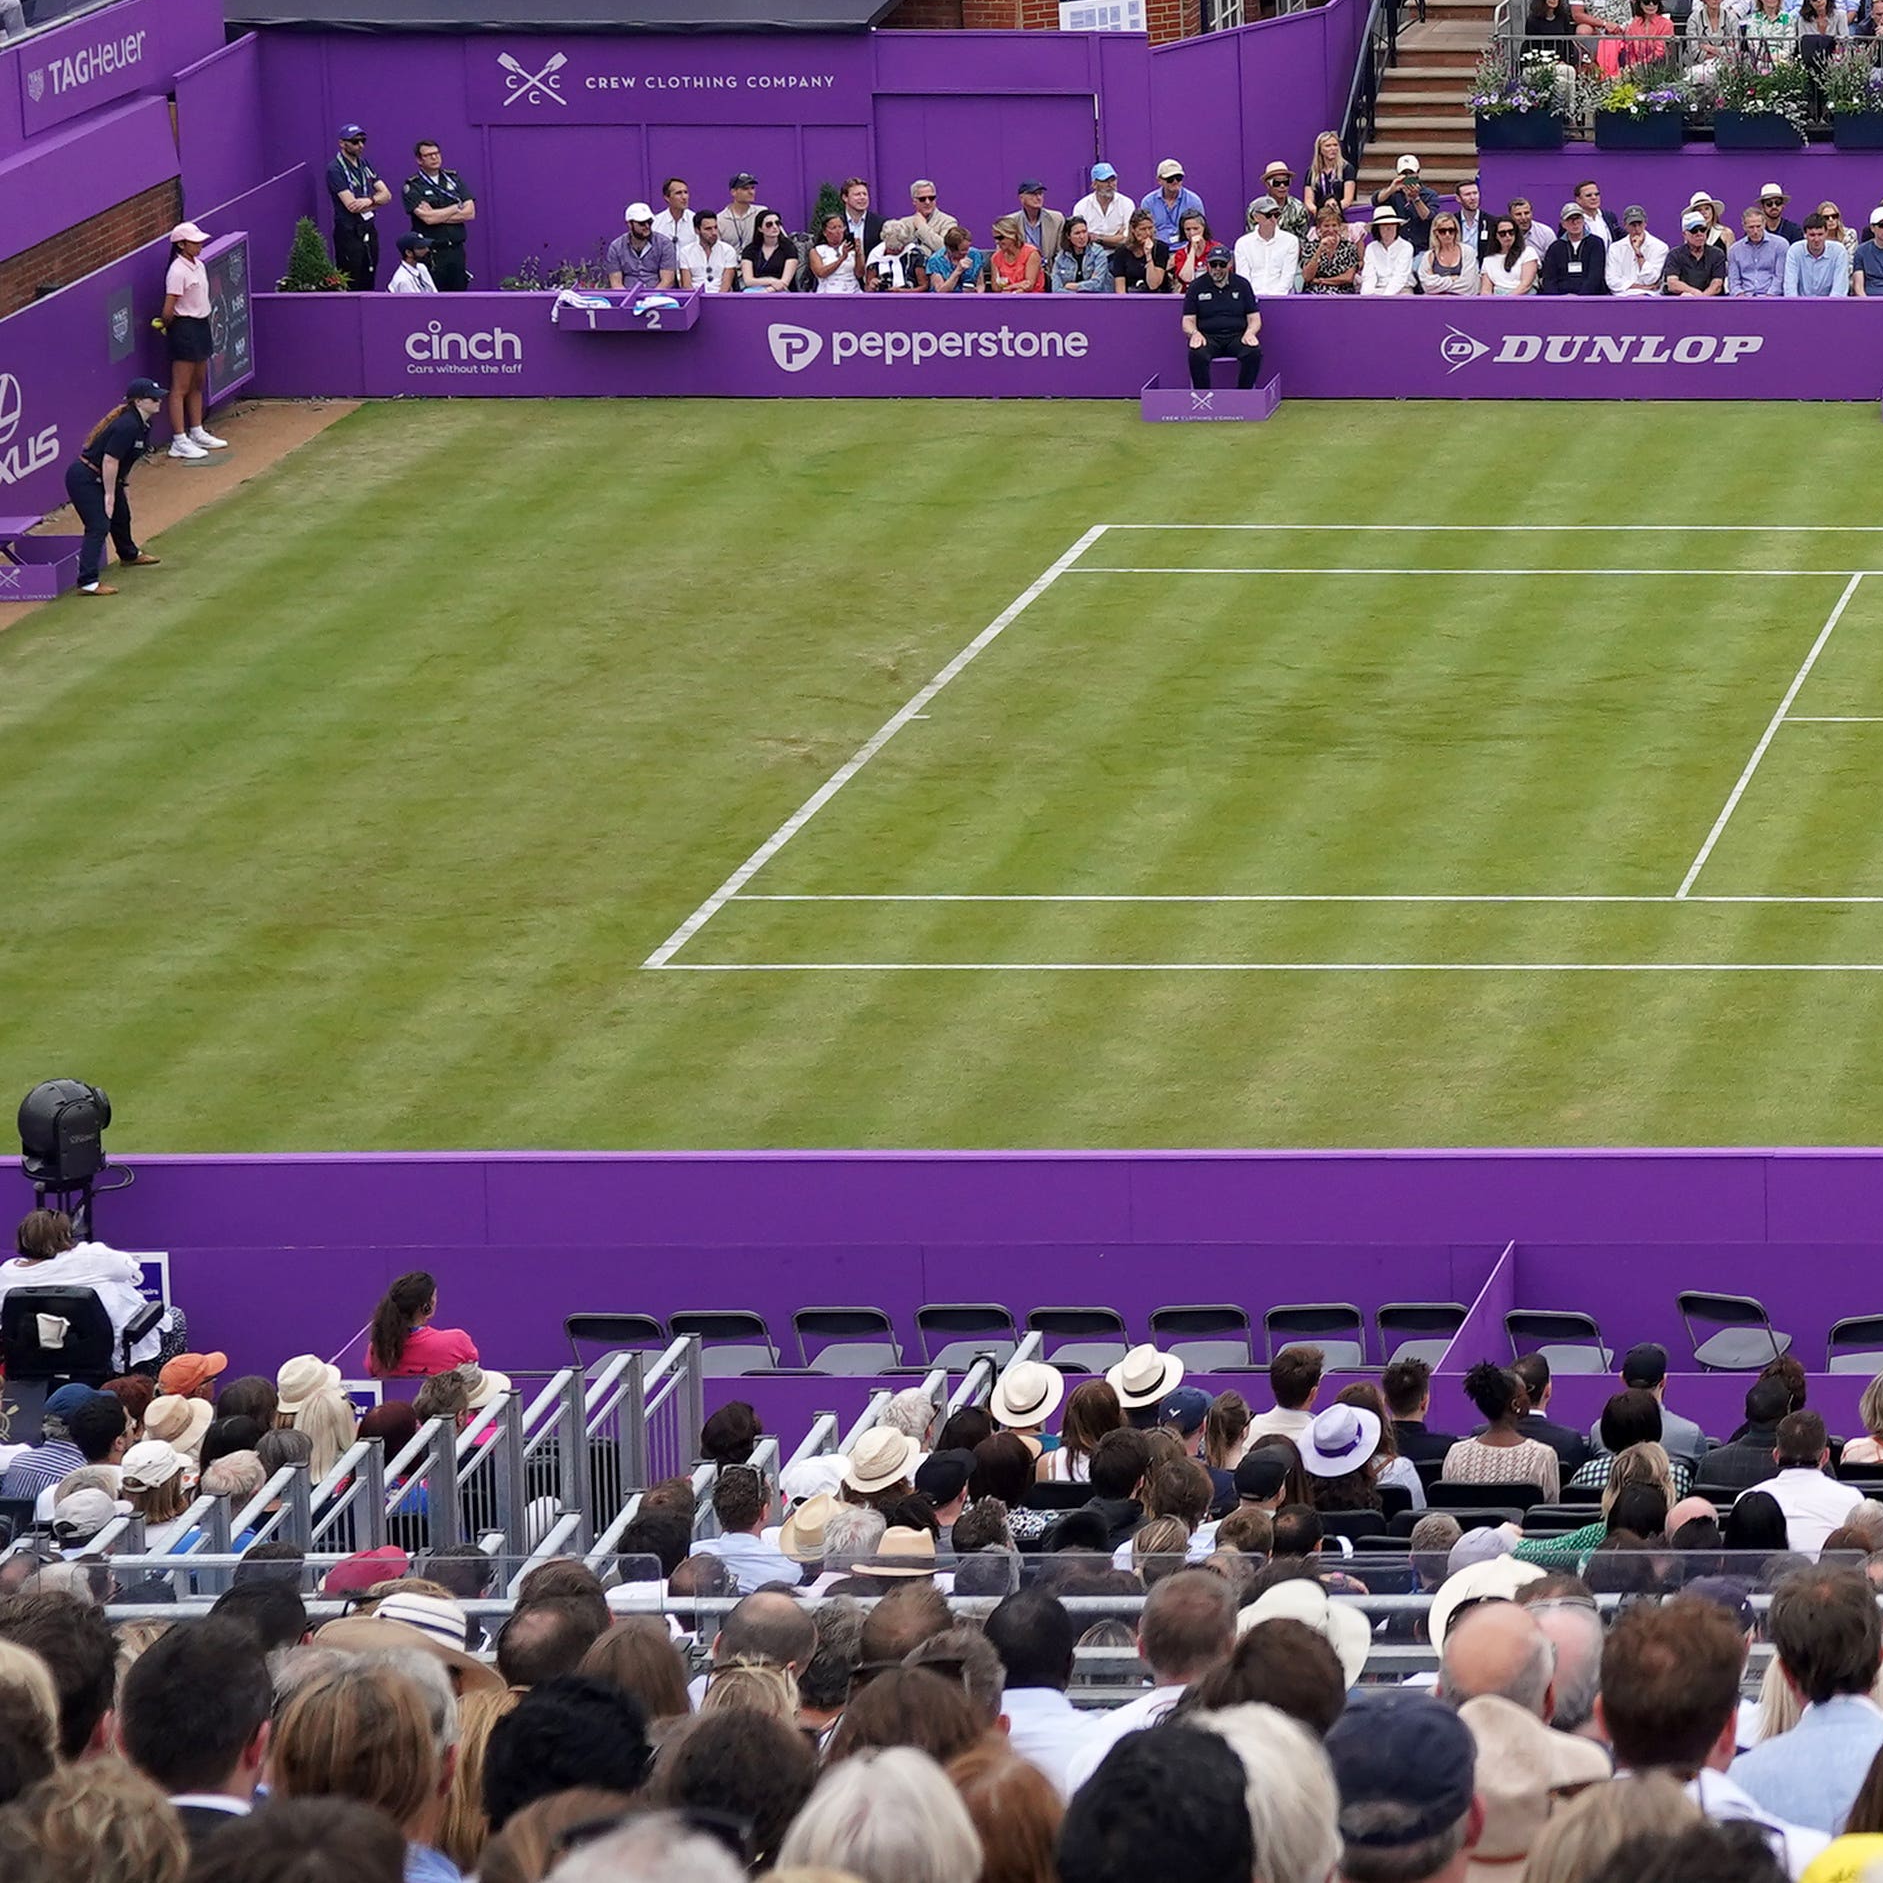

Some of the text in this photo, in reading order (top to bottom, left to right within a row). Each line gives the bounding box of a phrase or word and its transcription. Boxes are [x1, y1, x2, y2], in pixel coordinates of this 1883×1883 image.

[585, 75, 835, 89] CREW CLOTHING COMPANY
[586, 310, 662, 329] 1 2
[405, 320, 522, 360] cinch
[832, 325, 1089, 365] pepperstone
[1492, 335, 1764, 364] DUNLOP
[407, 364, 522, 374] Cars without the faff
